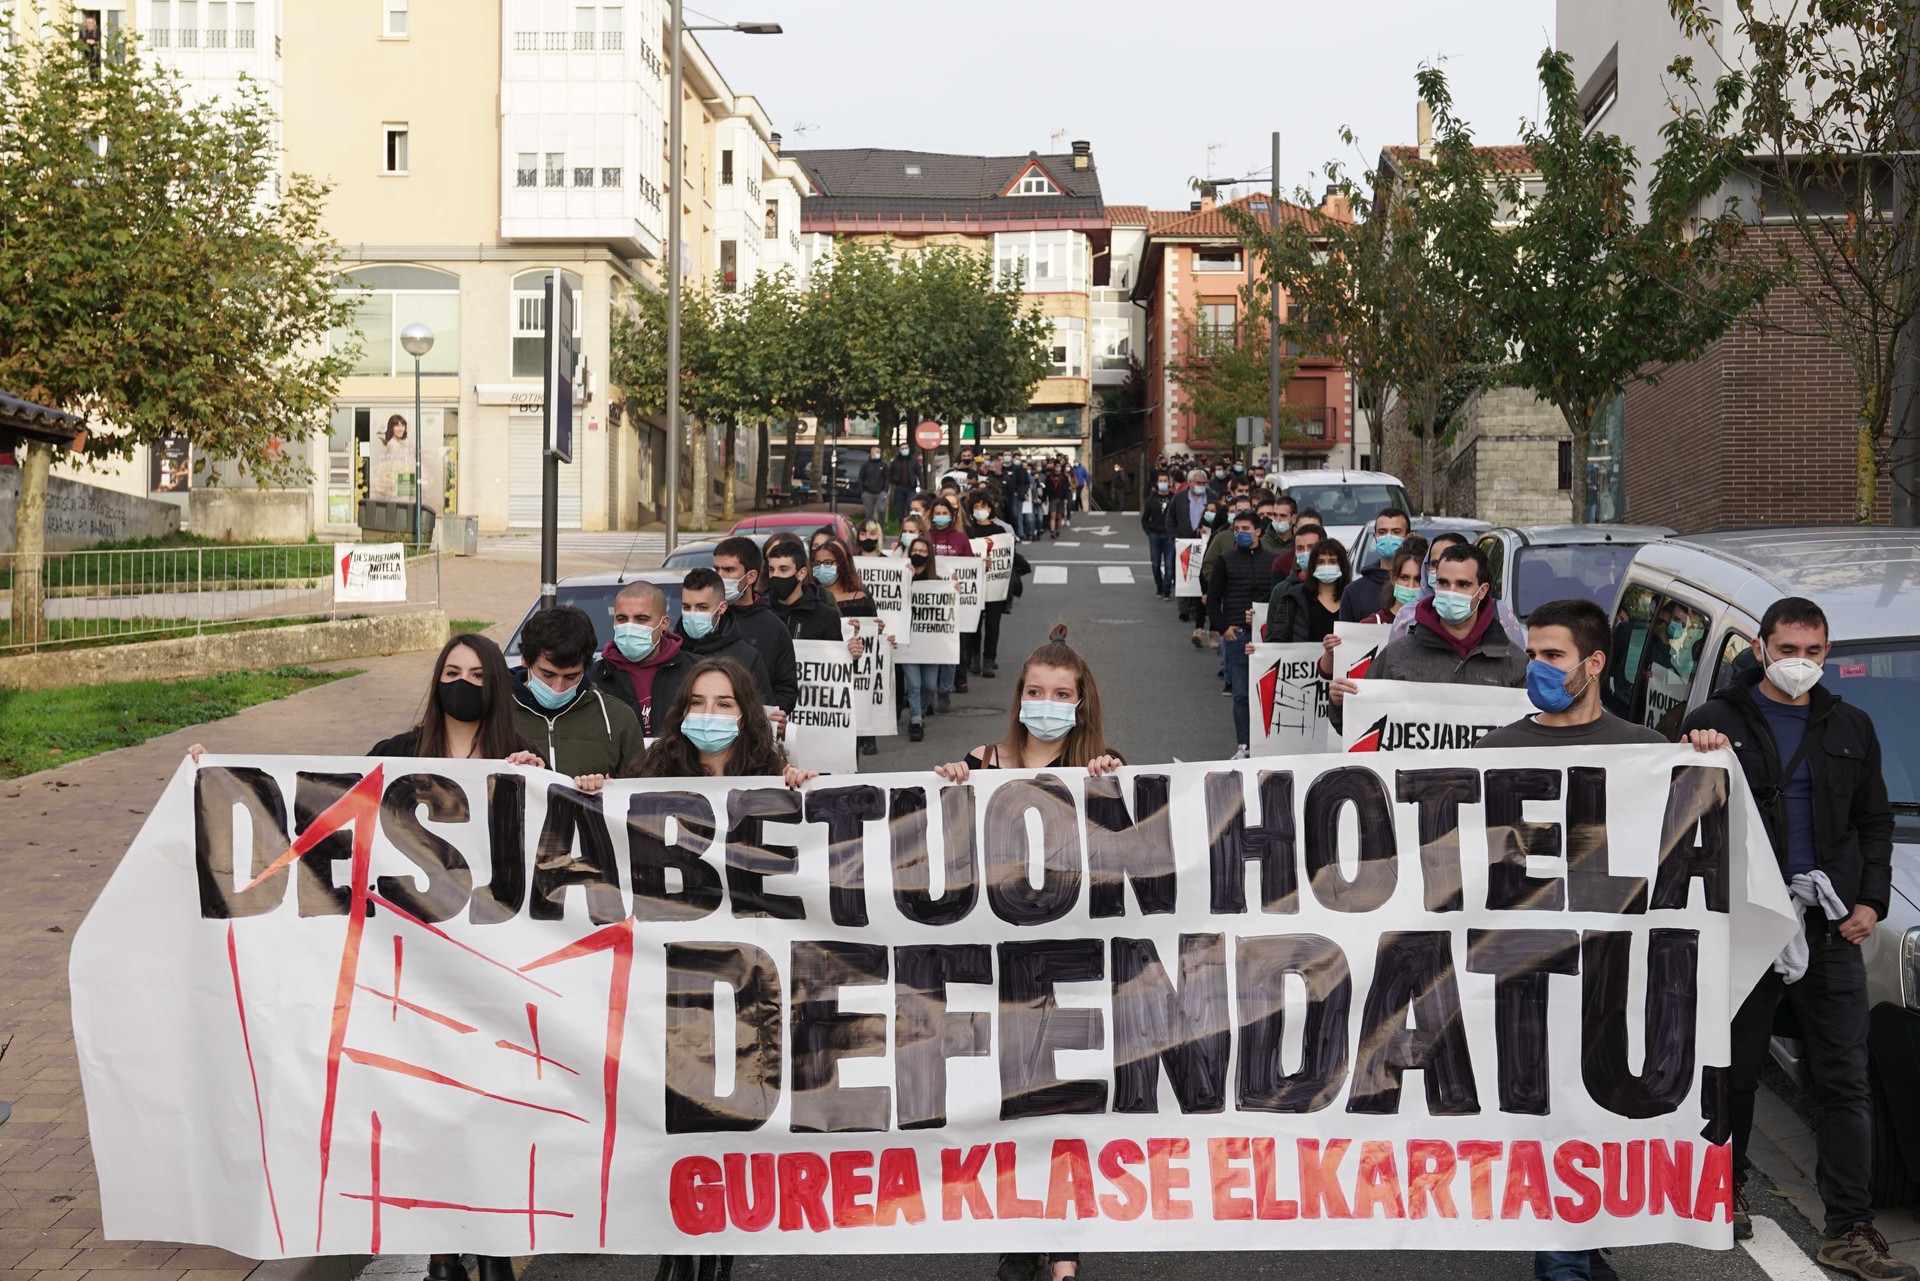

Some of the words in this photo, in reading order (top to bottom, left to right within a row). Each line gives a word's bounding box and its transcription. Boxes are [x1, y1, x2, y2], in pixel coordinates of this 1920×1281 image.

[511, 393, 544, 403] BOTIK
[911, 592, 956, 606] ABETUON
[912, 606, 955, 622] HOTELA
[912, 622, 955, 634] DEFENDATU
[796, 661, 853, 683] BETUON
[797, 684, 851, 709] OTELA
[1385, 722, 1503, 750] DESJABE
[194, 766, 1177, 927] DESJABETUON
[1204, 765, 1731, 915] HOTELA
[669, 1147, 927, 1236] GUREA
[941, 1137, 1194, 1222] KLASE
[1207, 1137, 1733, 1225] ELKARTASUNA
